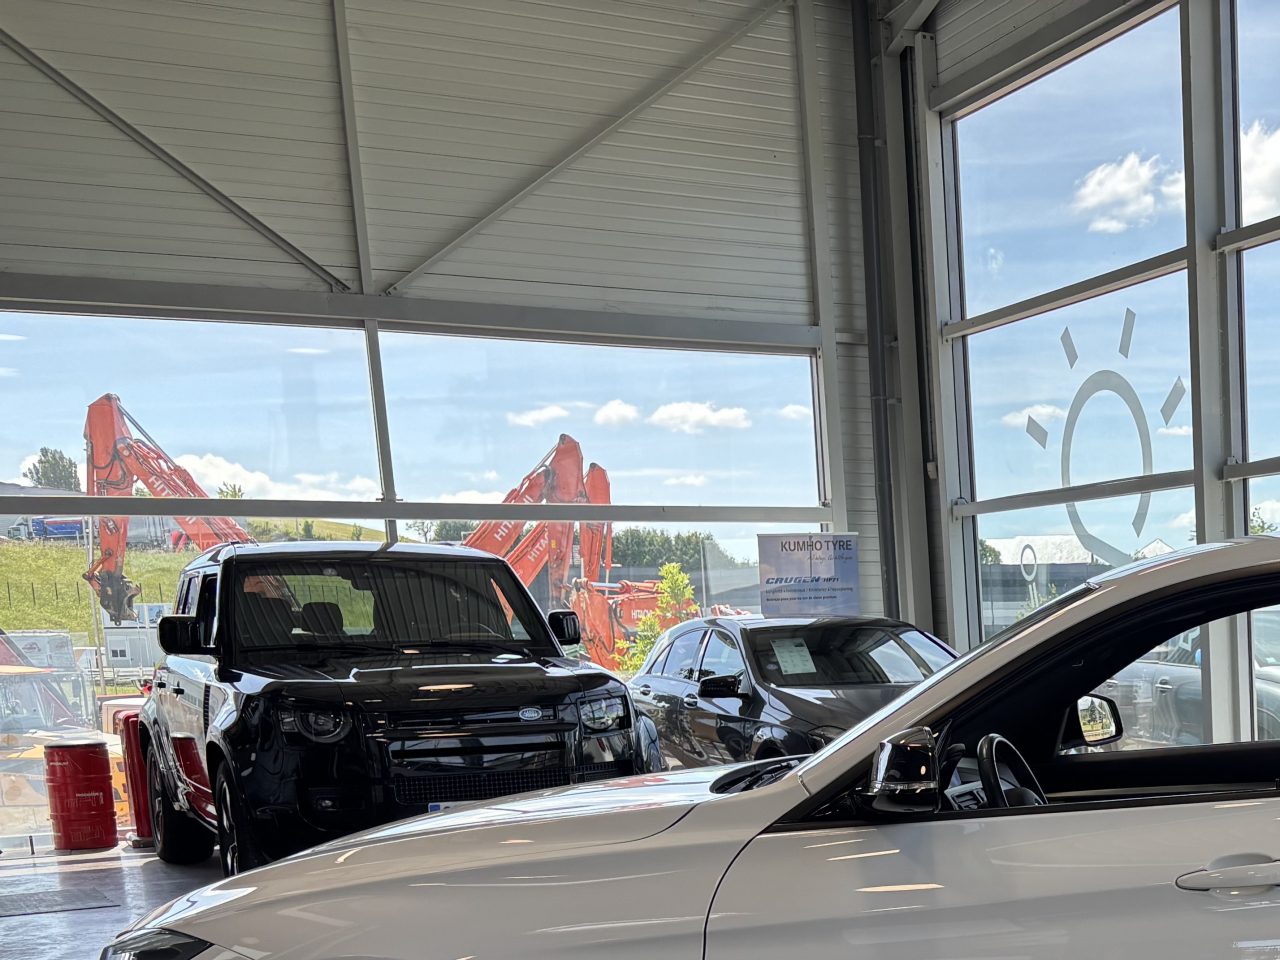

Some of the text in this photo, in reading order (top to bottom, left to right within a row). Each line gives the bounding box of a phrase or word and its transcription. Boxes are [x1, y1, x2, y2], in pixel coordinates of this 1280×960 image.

[781, 540, 852, 552] KUMHO TYRE
[765, 576, 821, 585] CRUGEN
